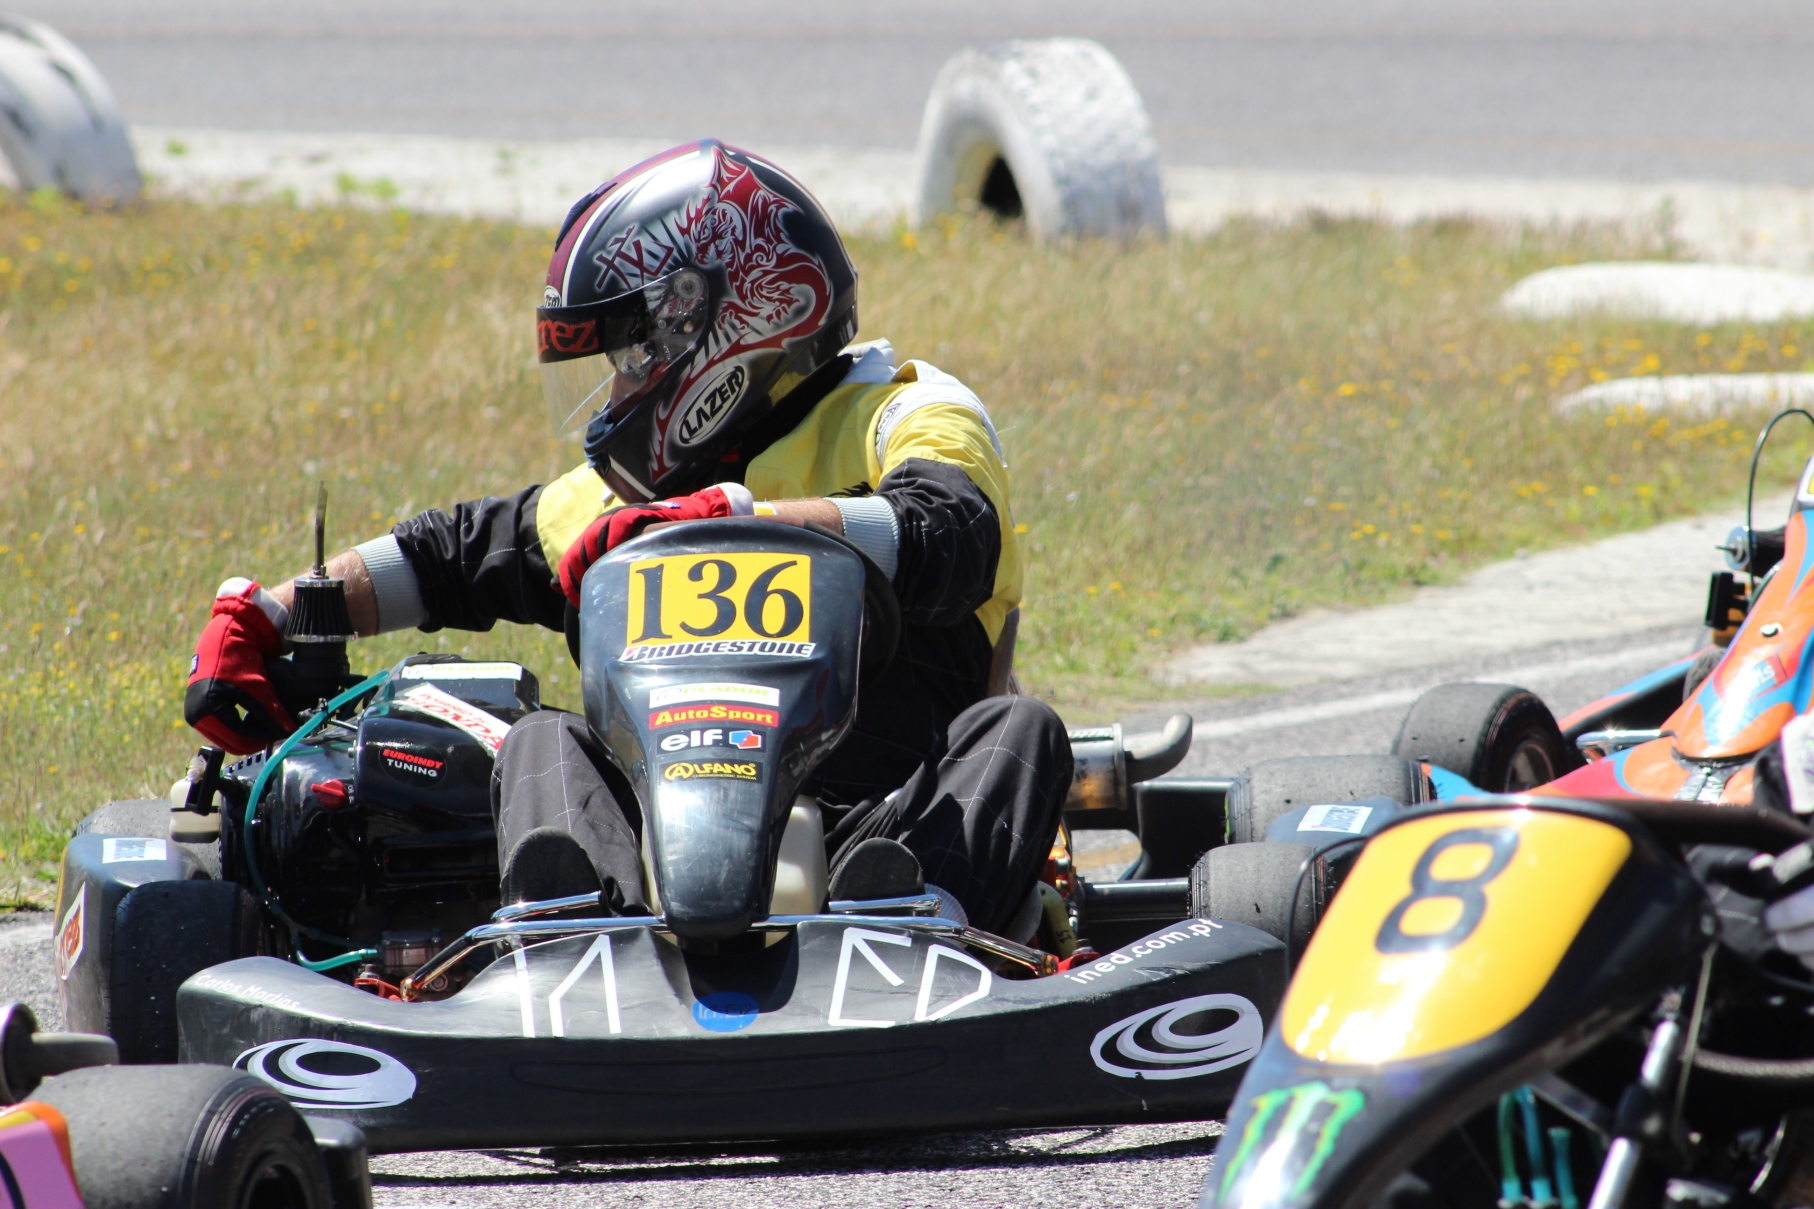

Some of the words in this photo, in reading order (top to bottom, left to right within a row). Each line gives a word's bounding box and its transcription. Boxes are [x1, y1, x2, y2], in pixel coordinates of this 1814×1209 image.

[684, 371, 742, 438] LAZER
[631, 558, 804, 644] 136
[621, 640, 814, 661] BRIDGESTONE
[654, 705, 773, 727] AutoSport
[660, 728, 723, 752] elf
[382, 749, 444, 770] EUROINDY
[386, 758, 438, 778] TUNING
[664, 762, 757, 781] ALFANO
[1375, 826, 1520, 955] 8
[1064, 917, 1224, 985] ined.com.pt
[194, 974, 243, 994] Carlos
[240, 984, 301, 1010] Martins
